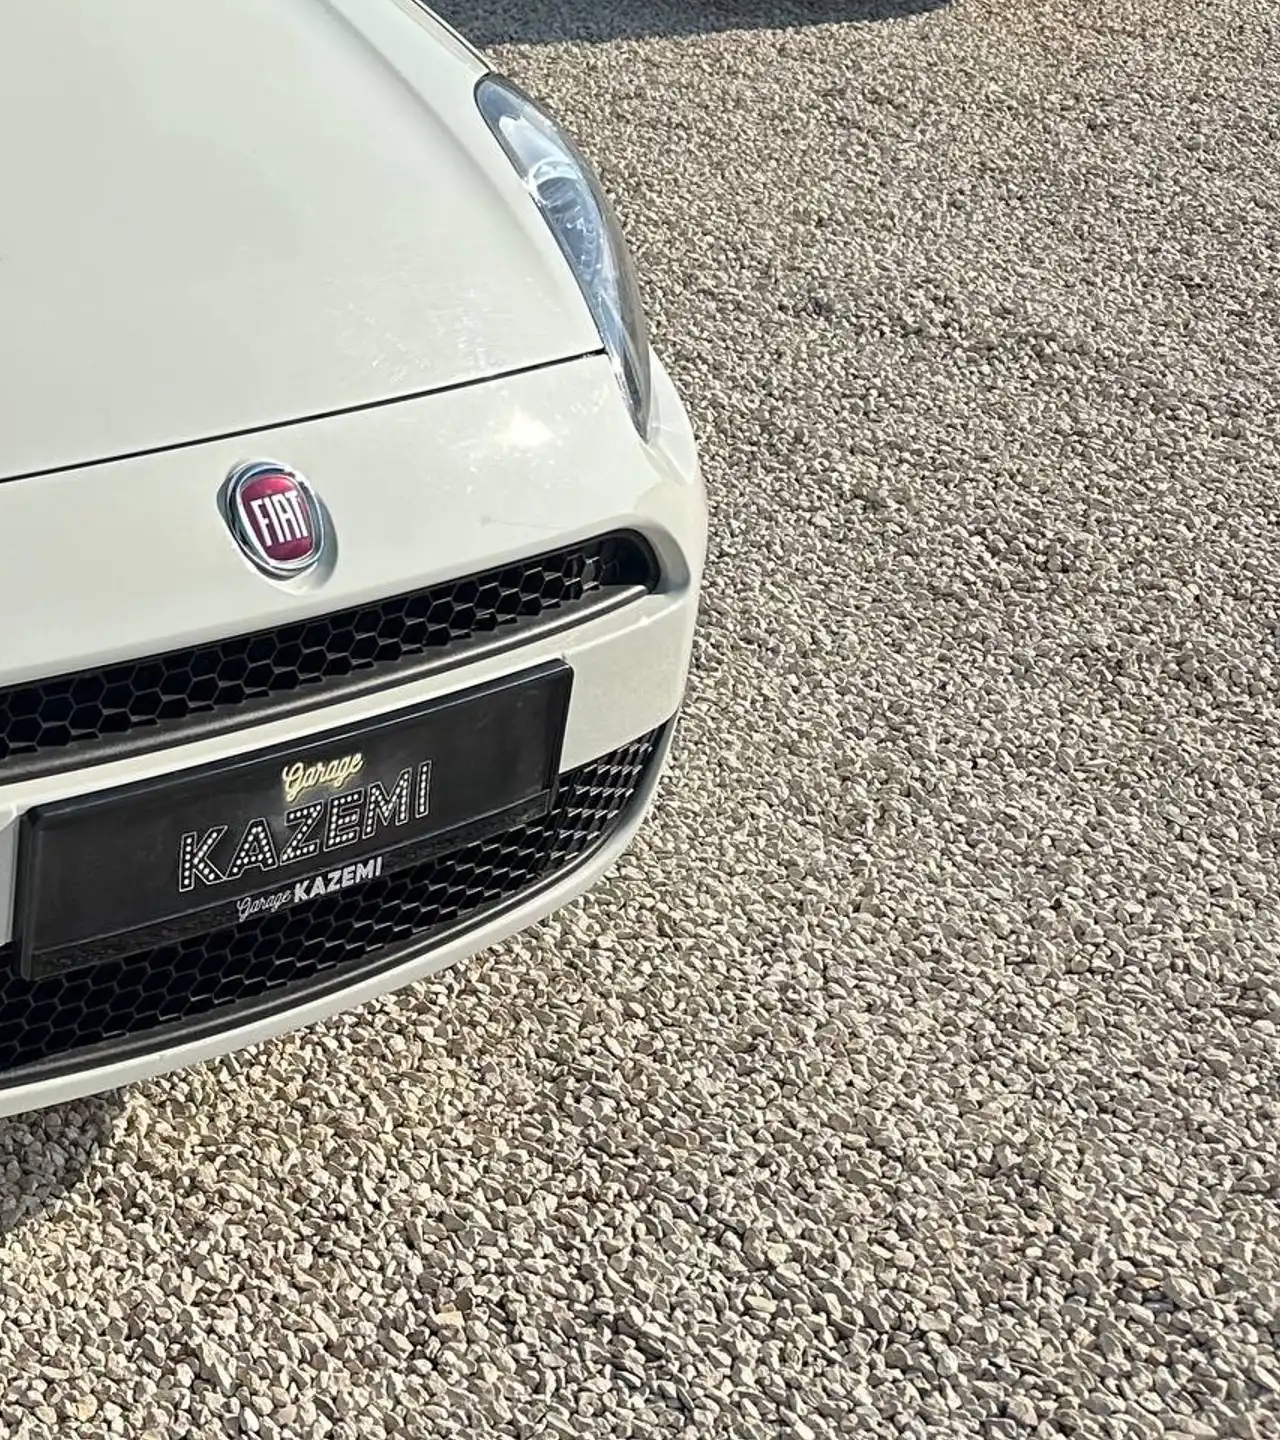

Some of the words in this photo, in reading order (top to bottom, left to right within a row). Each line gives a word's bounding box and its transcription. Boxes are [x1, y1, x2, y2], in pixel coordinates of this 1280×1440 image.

[249, 489, 309, 547] FIAT
[282, 752, 363, 803] Garage
[179, 759, 432, 892] KAZEMI
[237, 889, 291, 922] Garage
[293, 856, 383, 903] KAZEMI
